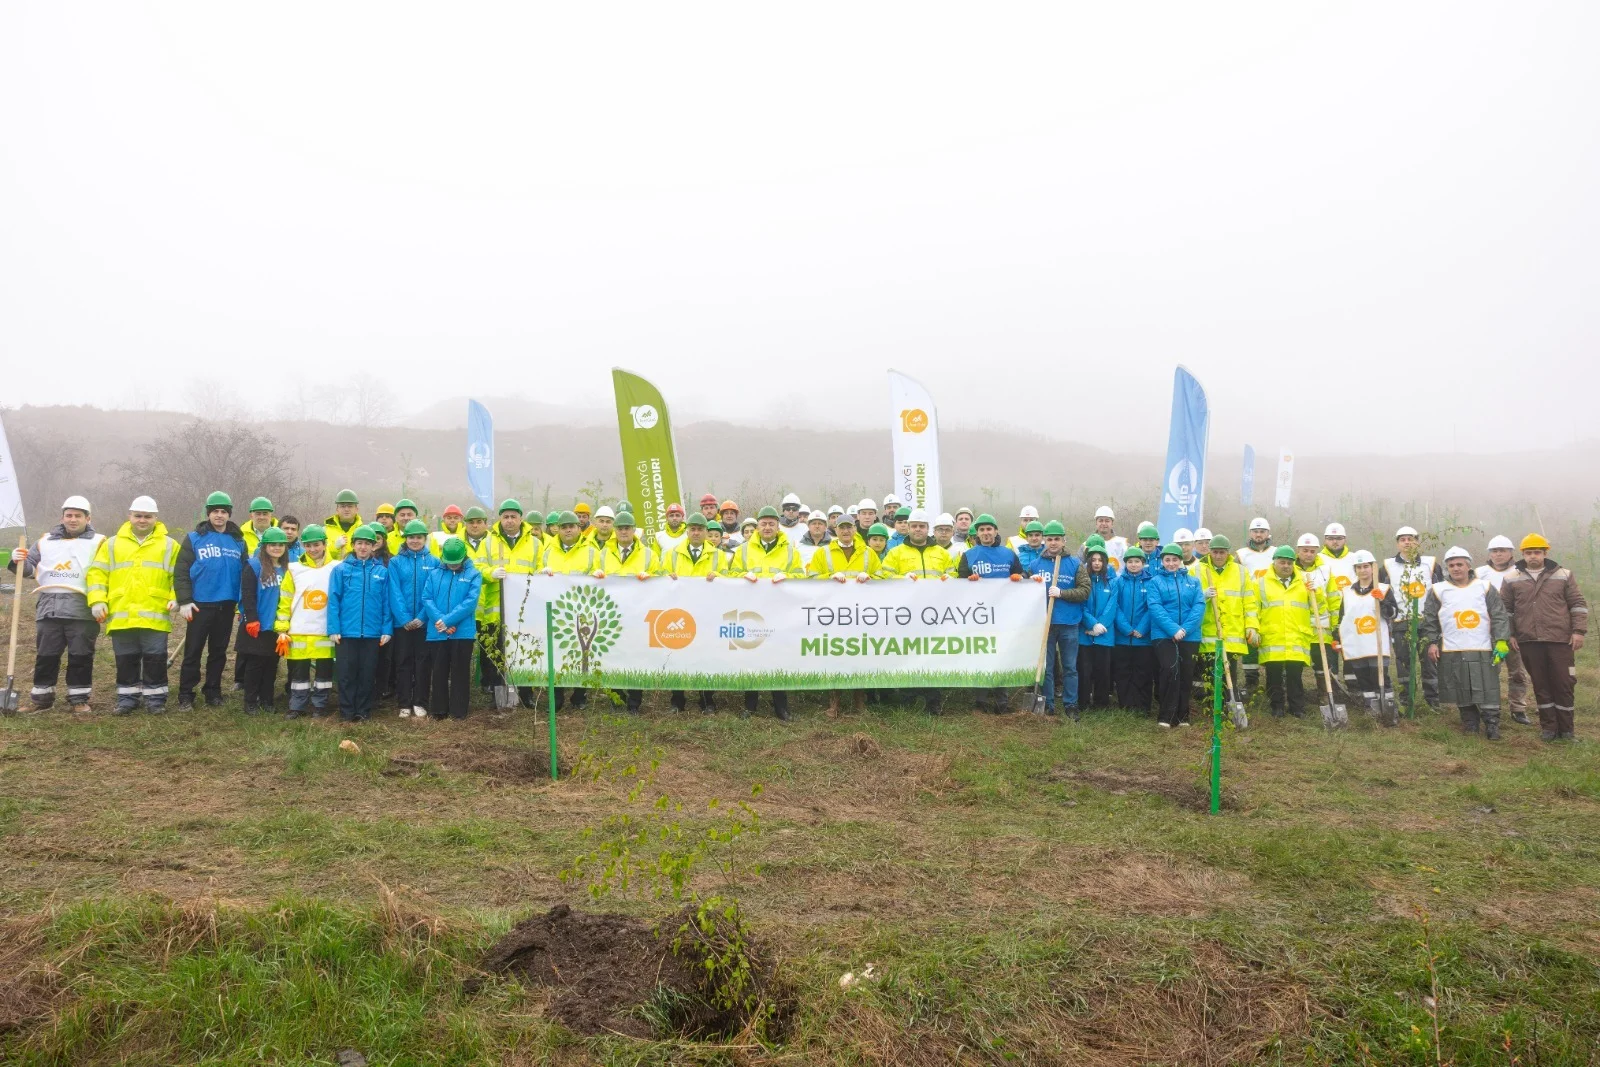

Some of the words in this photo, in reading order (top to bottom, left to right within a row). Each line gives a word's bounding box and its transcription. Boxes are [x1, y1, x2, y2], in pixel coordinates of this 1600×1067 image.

[651, 458, 667, 531] SİYAMIZDIR!
[916, 463, 926, 510] MIZDIR!
[644, 608, 697, 650] 10
[801, 603, 912, 626] TƏBİƏTƏ
[921, 602, 996, 626] QAYĞI
[801, 632, 997, 656] MİSSİYAMIZDIR!
